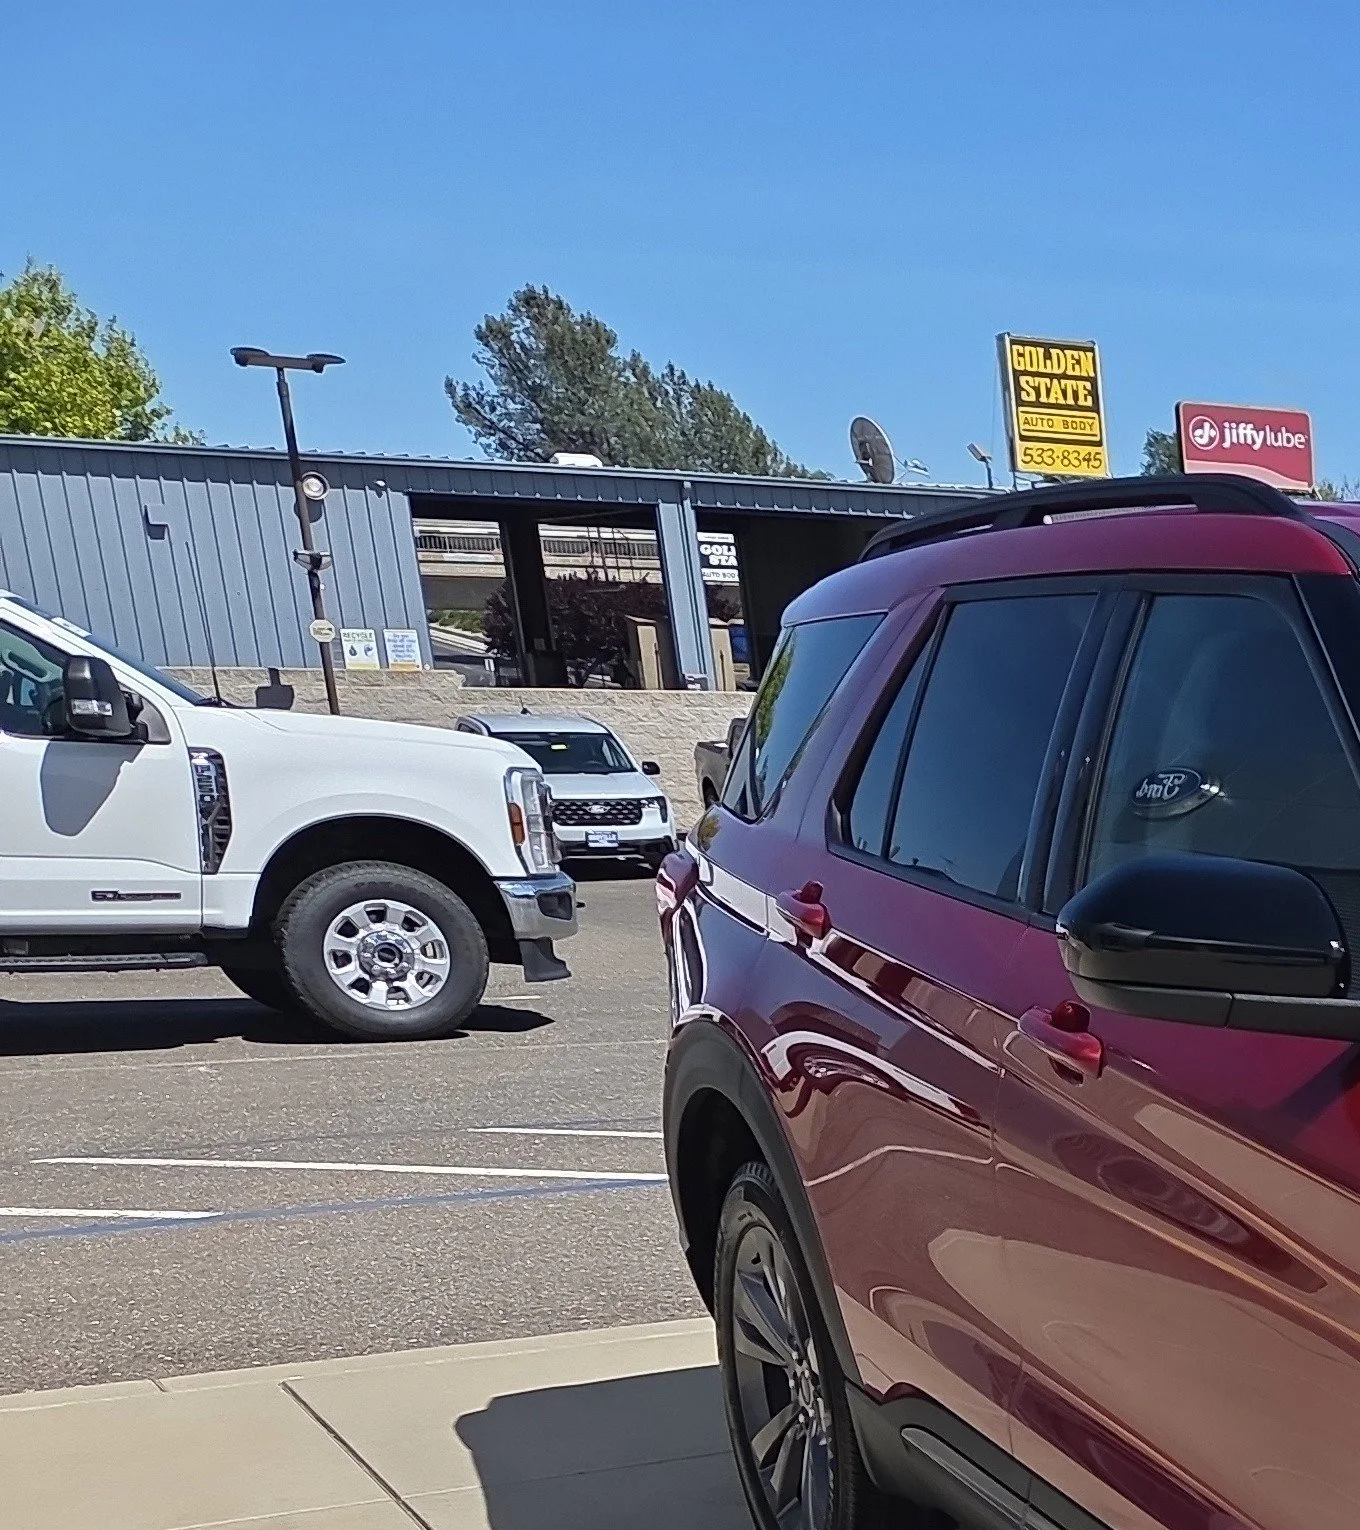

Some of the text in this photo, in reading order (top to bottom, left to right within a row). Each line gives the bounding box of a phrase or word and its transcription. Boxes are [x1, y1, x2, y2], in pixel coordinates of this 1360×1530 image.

[1011, 344, 1096, 378] GOLDEN
[1018, 375, 1094, 407] STATE
[1022, 416, 1095, 432] AUTO BODY
